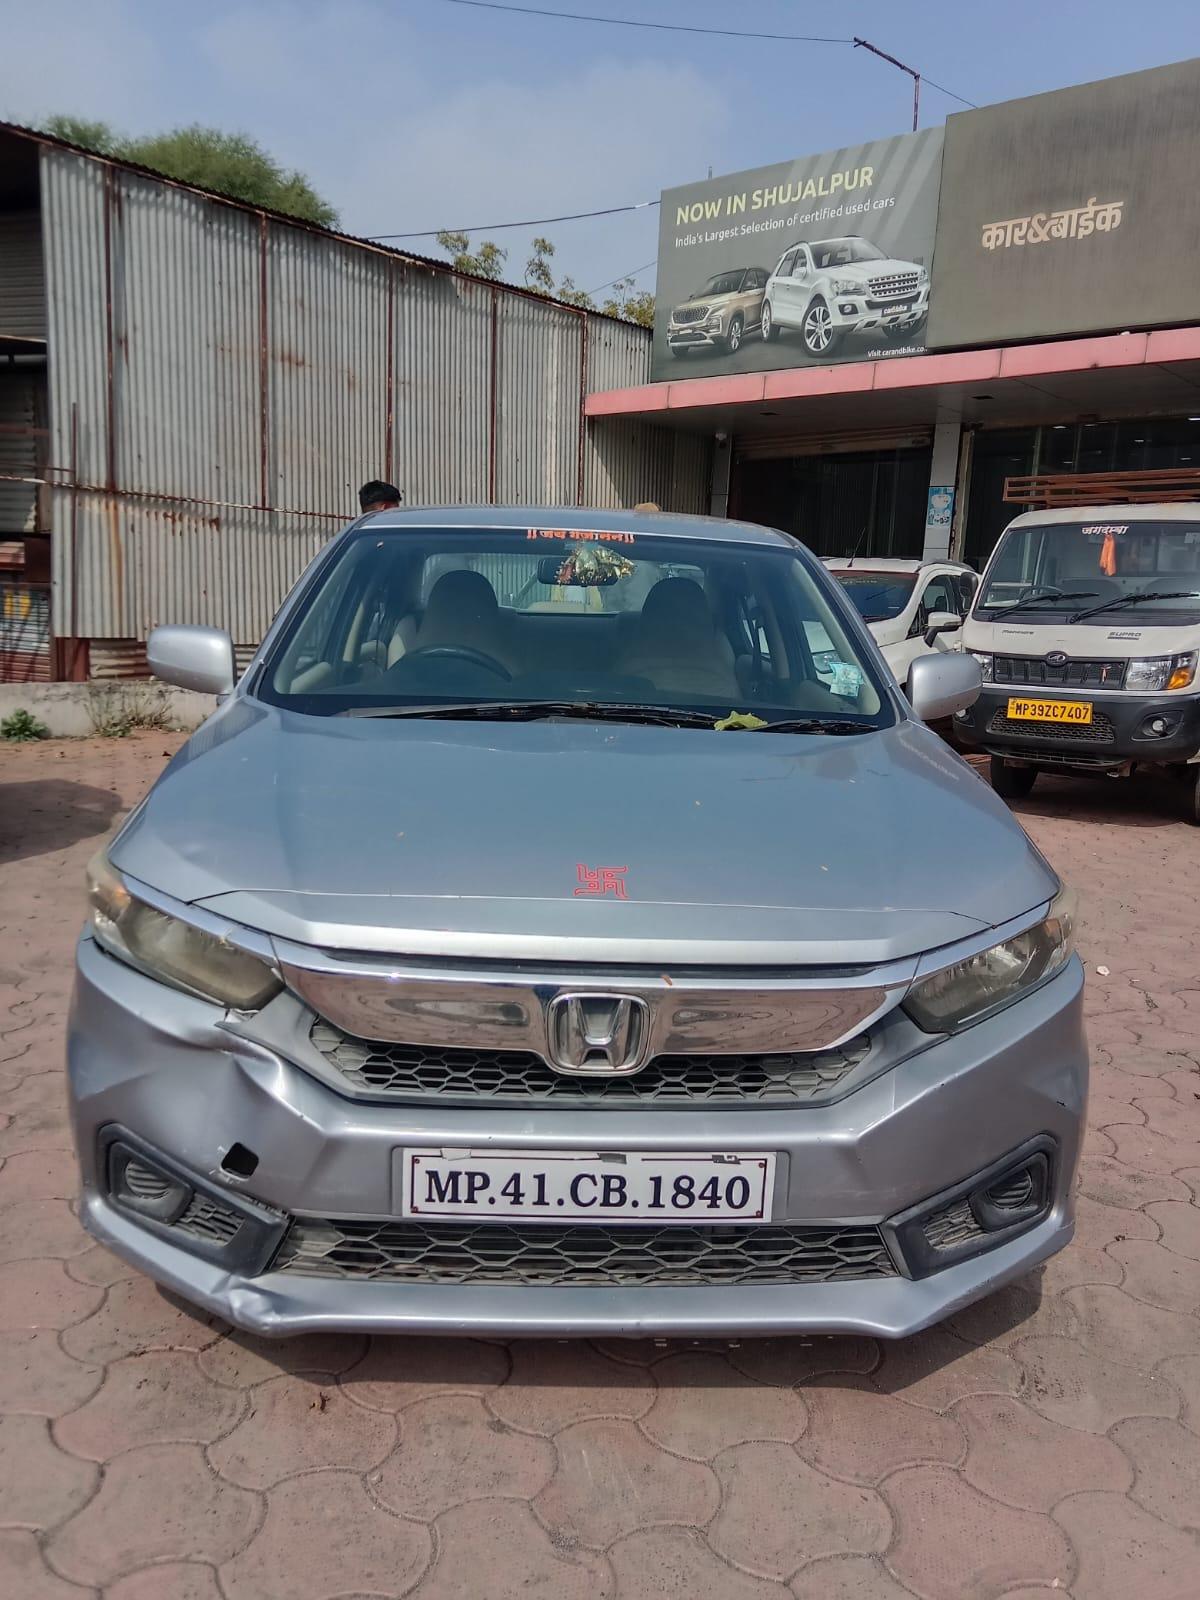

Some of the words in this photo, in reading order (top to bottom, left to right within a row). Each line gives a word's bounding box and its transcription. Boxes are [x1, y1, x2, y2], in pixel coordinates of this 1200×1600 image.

[676, 198, 722, 225] NOW
[726, 193, 746, 215] IN
[752, 166, 874, 211] SHUJALPUR
[675, 232, 703, 248] India's
[705, 226, 738, 243] Largest
[741, 217, 784, 235] Selection
[787, 212, 799, 226] of
[800, 204, 842, 224] certified
[846, 199, 869, 214] used
[873, 197, 895, 210] cars
[1015, 702, 1090, 720] MP39ZC7407
[424, 1169, 751, 1209] MP.41.CB.1840
